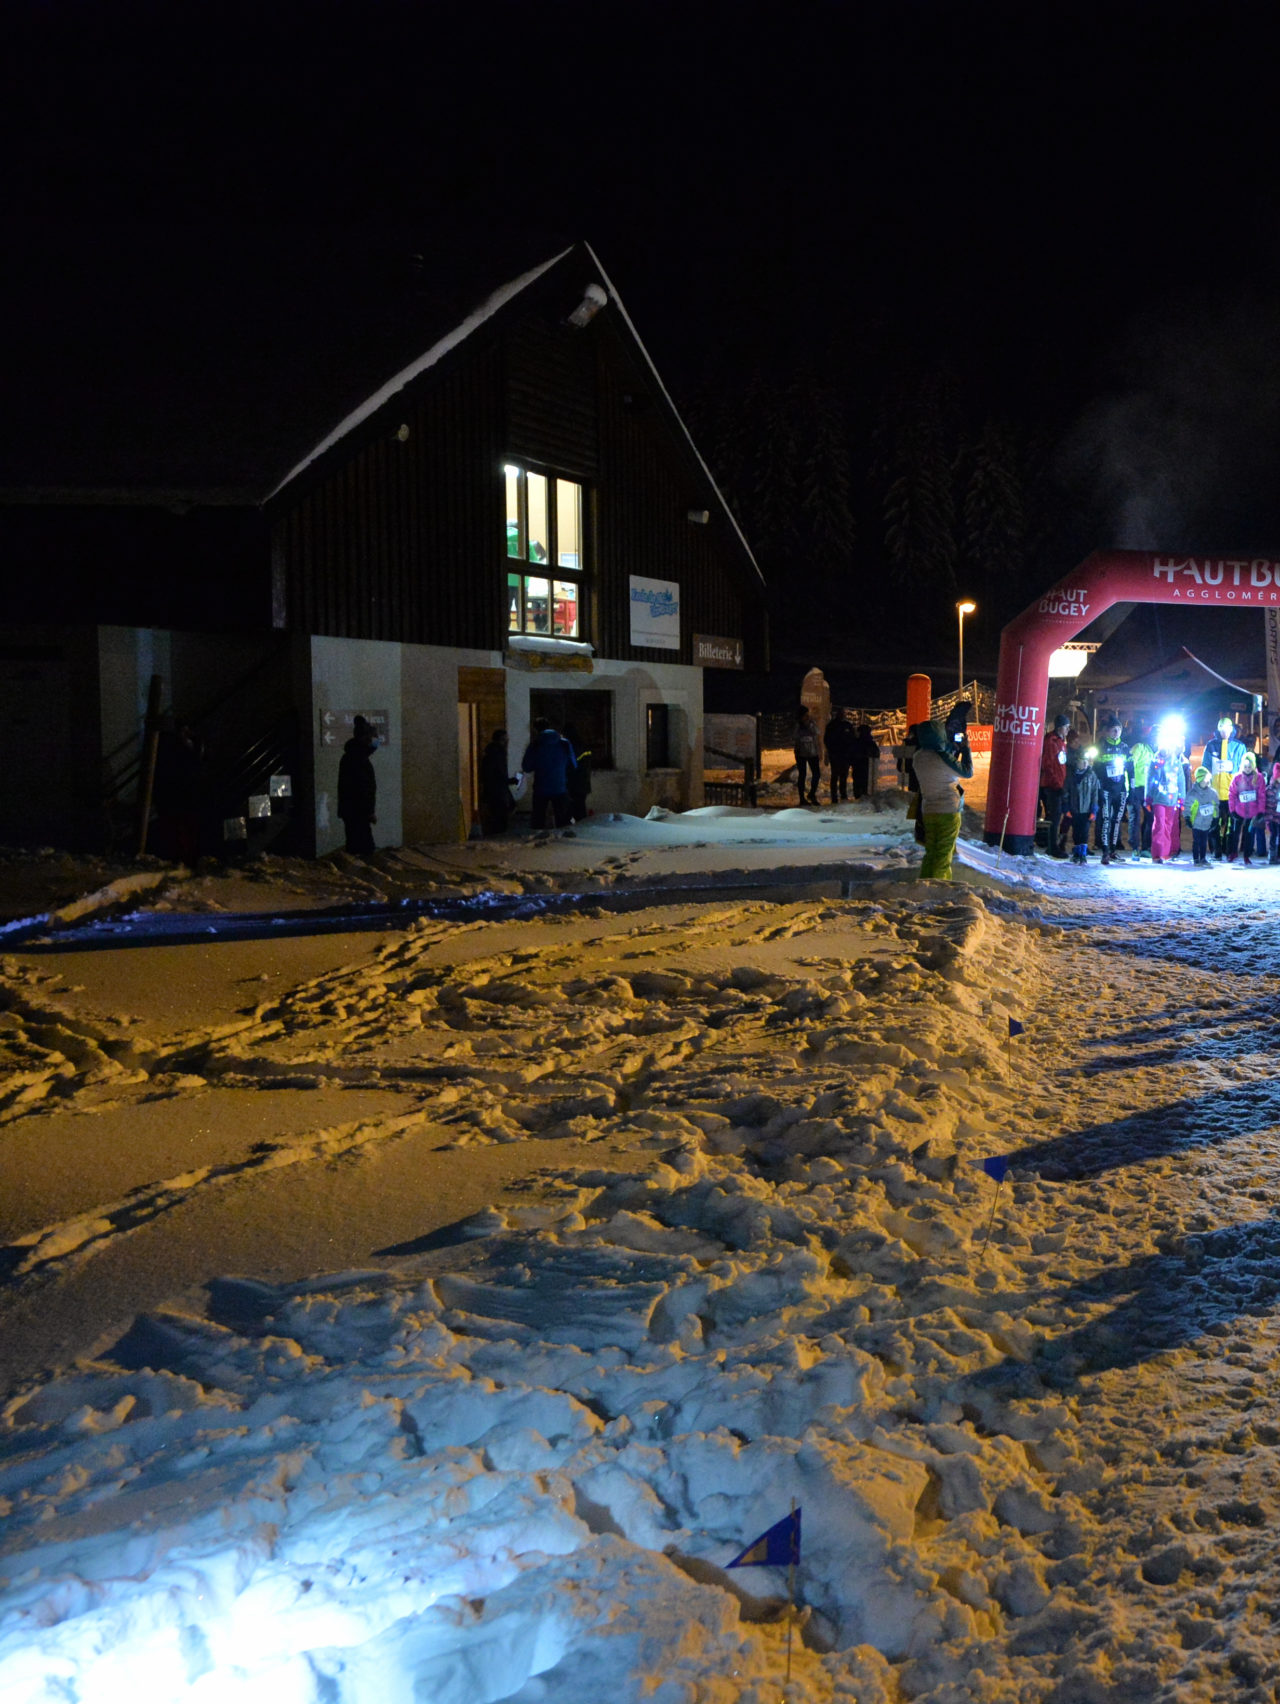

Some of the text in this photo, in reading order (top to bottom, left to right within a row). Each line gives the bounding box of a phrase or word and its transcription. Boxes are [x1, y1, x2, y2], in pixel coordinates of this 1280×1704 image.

[1046, 588, 1088, 602] HAUT
[1039, 600, 1090, 616] BUGEY
[997, 703, 1040, 721] HAUT
[994, 716, 1041, 736] BUGEY
[967, 729, 991, 741] BUGEY
